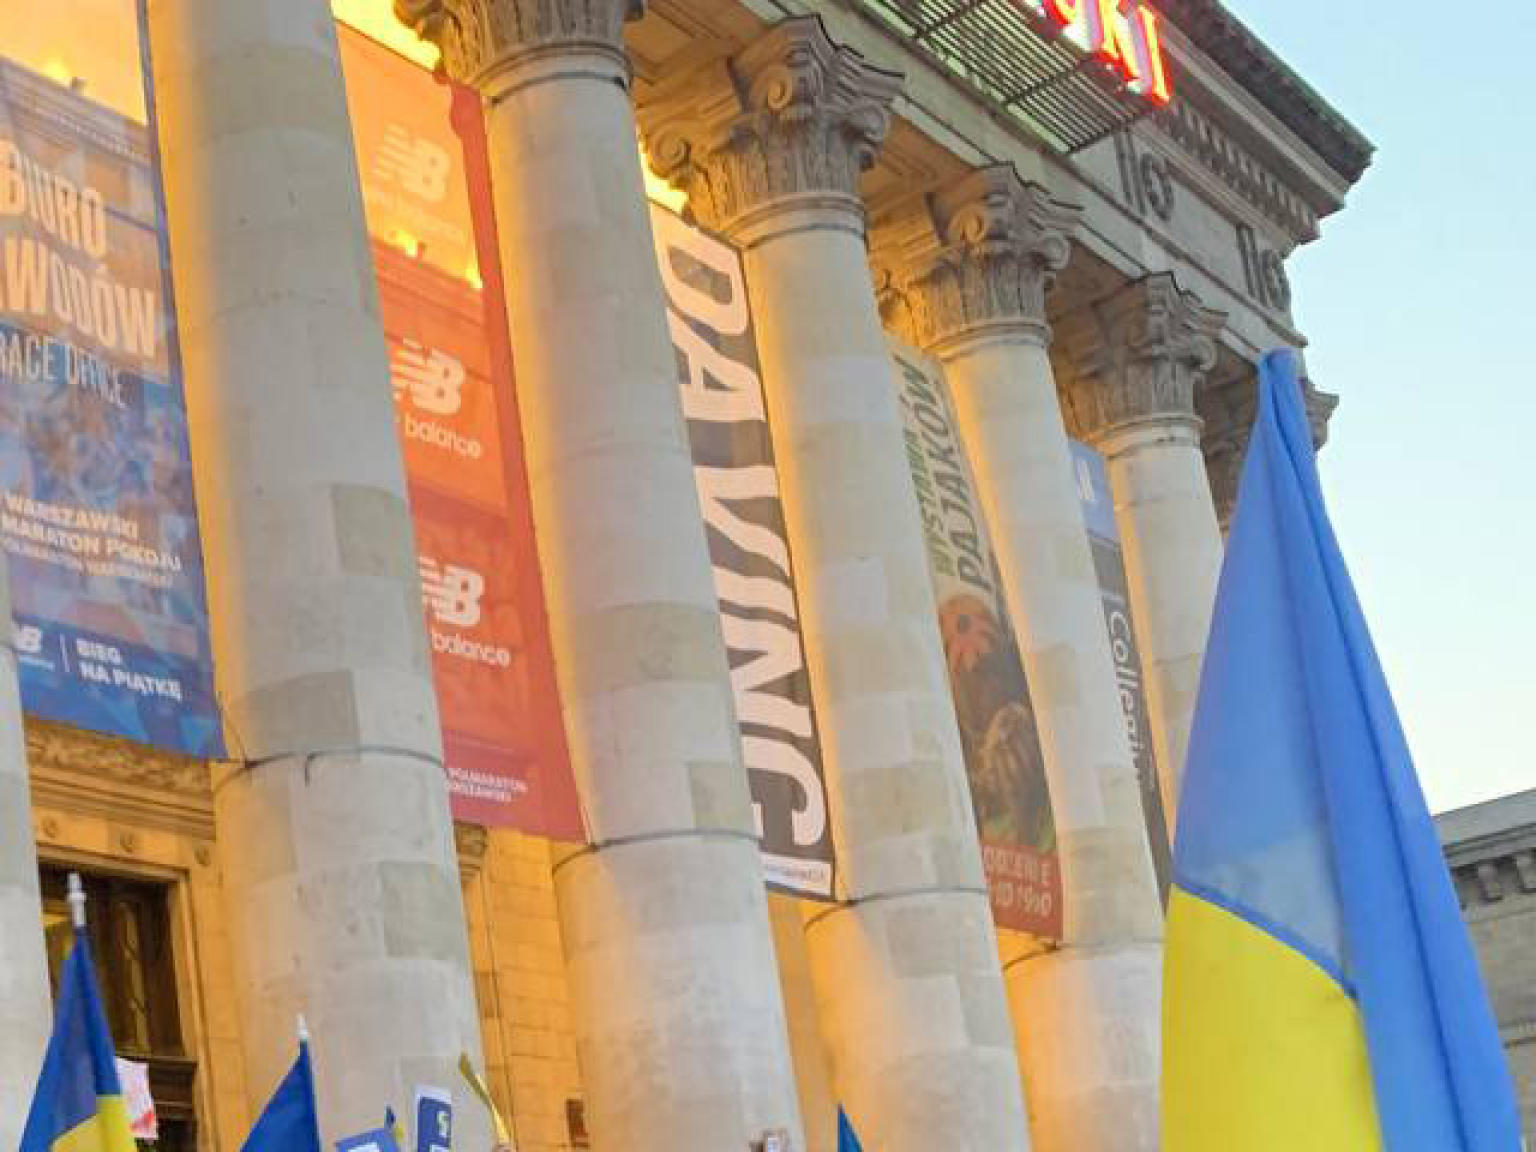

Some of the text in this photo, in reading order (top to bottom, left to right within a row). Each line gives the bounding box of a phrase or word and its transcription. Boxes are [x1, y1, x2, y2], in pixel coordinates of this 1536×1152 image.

[648, 197, 765, 421] DA
[404, 417, 482, 460] balance
[431, 629, 512, 668] balance
